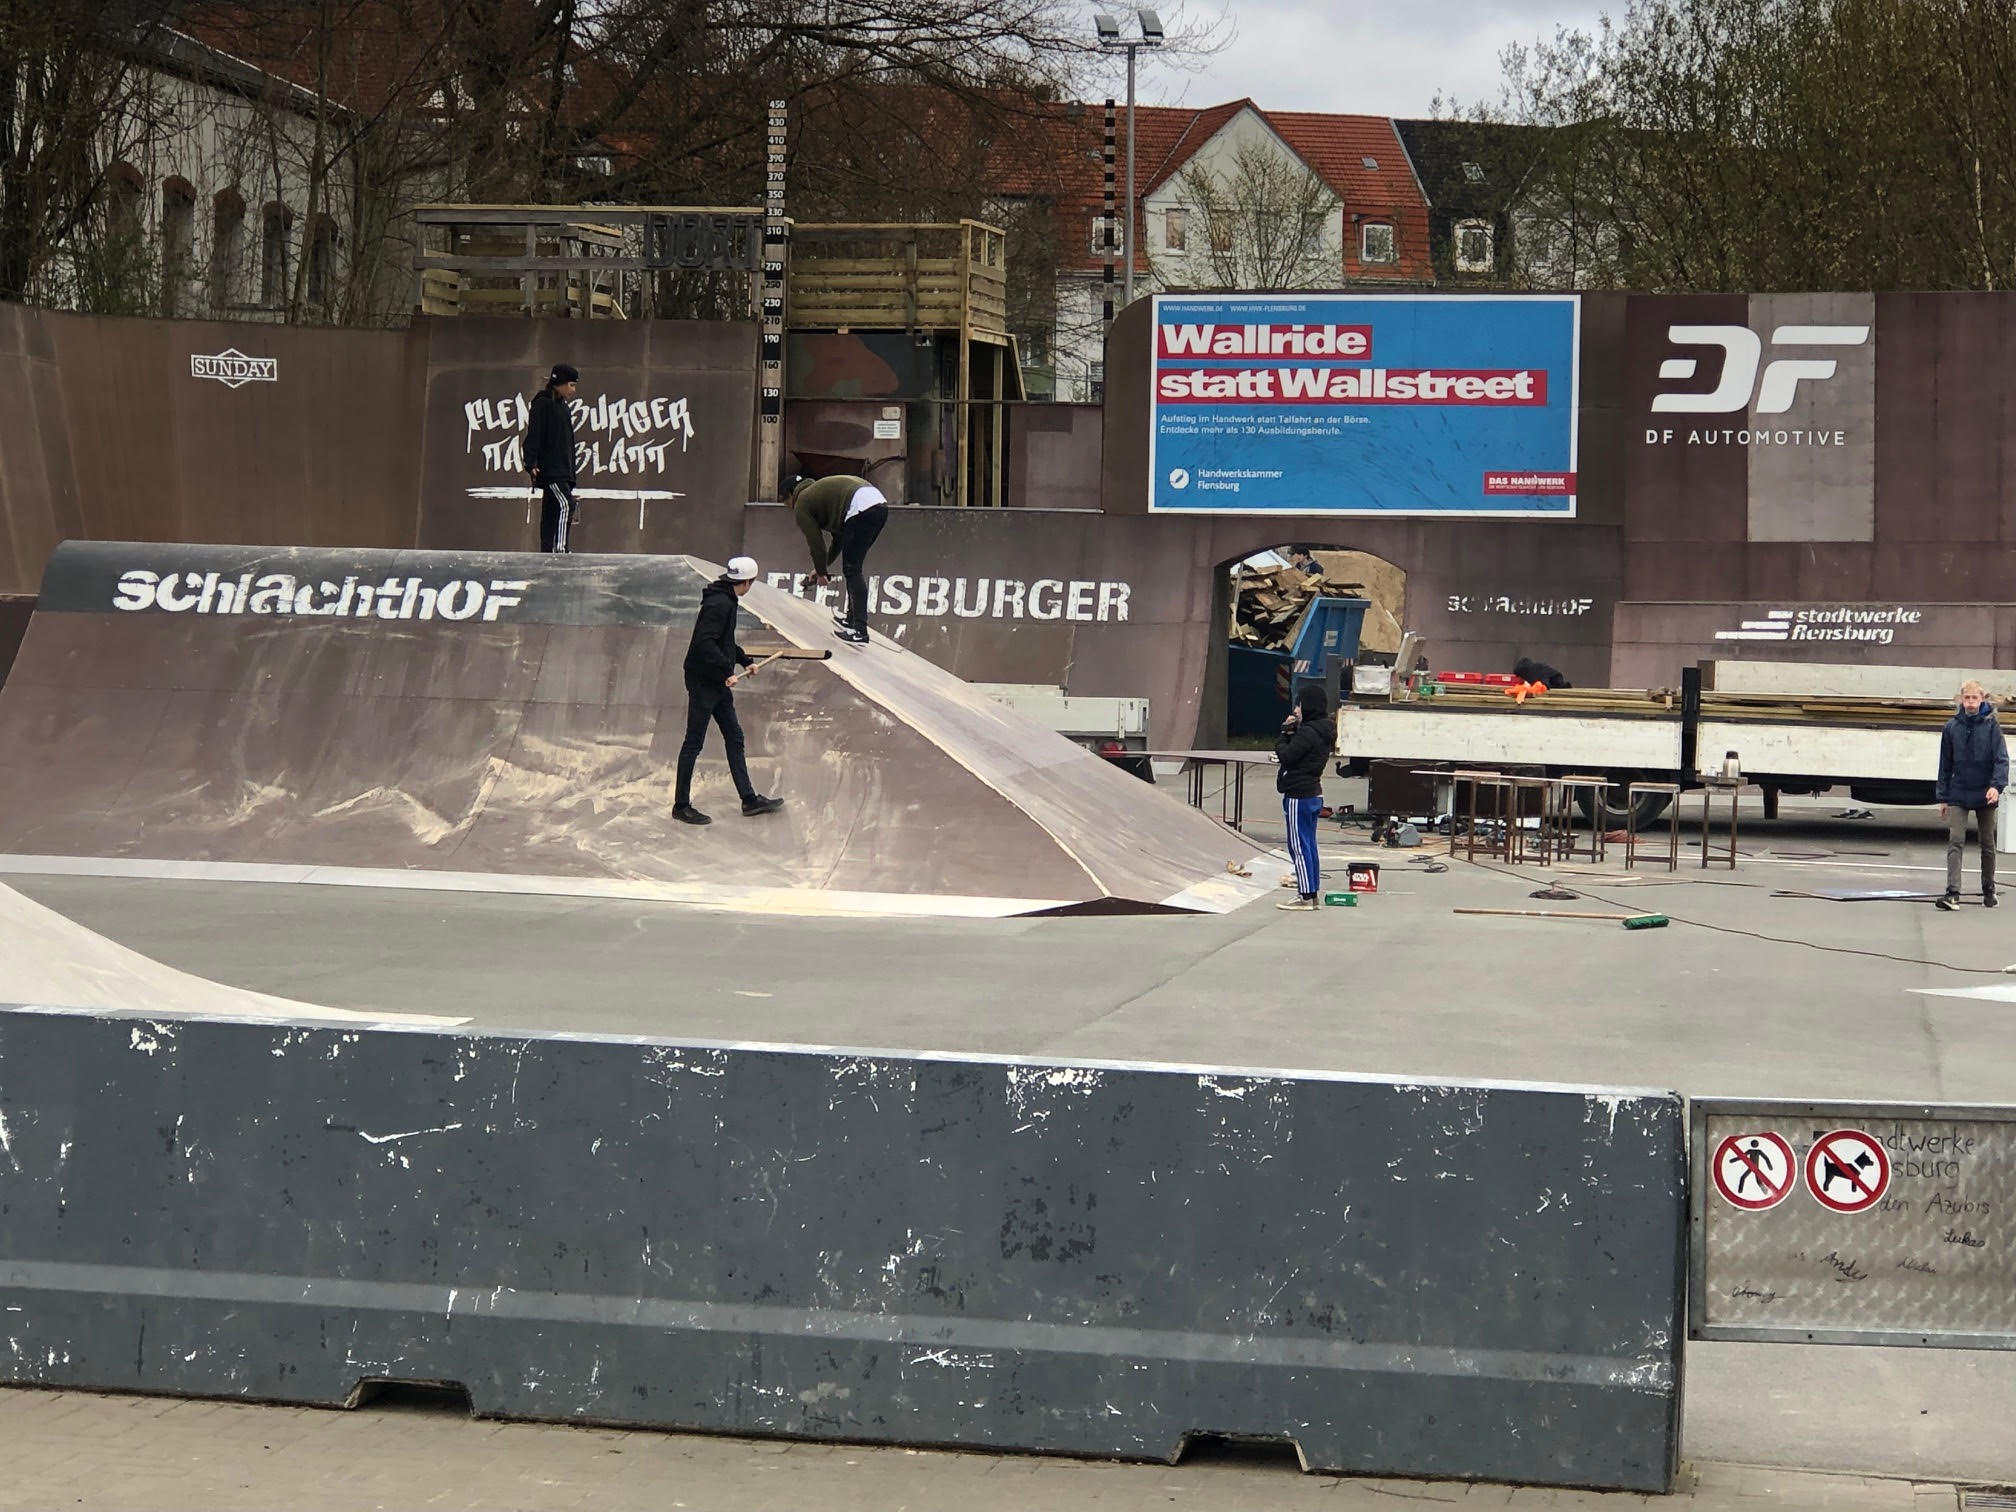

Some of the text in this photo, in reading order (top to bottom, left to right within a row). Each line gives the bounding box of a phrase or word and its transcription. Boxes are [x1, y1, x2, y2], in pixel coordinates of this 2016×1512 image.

[769, 100, 786, 109] 450
[768, 118, 785, 127] 430
[768, 136, 785, 145] 410
[768, 154, 784, 163] 390
[767, 172, 784, 181] 370
[767, 190, 784, 199] 350
[767, 208, 783, 217] 330
[766, 226, 782, 235] 310
[765, 262, 782, 271] 270
[765, 279, 781, 289] 250
[764, 298, 781, 307] 230
[764, 316, 780, 325] 210
[764, 334, 780, 343] 190
[1162, 324, 1367, 354] Wallride
[194, 358, 272, 377] SUNDAY
[763, 360, 779, 369] 160
[1651, 325, 1870, 413] DF
[1160, 368, 1534, 400] statt Wallstreet
[763, 388, 779, 397] 130
[465, 392, 695, 454] FLENBURGER
[762, 415, 778, 424] 100
[1161, 414, 1196, 424] Aufstieg
[1198, 415, 1210, 423] im
[1212, 415, 1255, 423] Handwerk
[1279, 415, 1312, 424] Talfahrt
[1327, 416, 1342, 424] der
[1344, 414, 1371, 424] Börse.
[1160, 426, 1343, 436] Entdecke mehr als 130 Ausbildungsberufe.
[1646, 430, 1845, 445] DF AUTOMOTIVE
[482, 434, 675, 476] TABLATT
[1198, 469, 1283, 478] Handwerkskammer
[1488, 476, 1565, 485] DAS HANDWERK
[1197, 481, 1240, 492] Flensburg
[1796, 607, 1922, 624] stadtwerke
[1791, 624, 1894, 644] flensburg
[1925, 1192, 1990, 1215] Azubis
